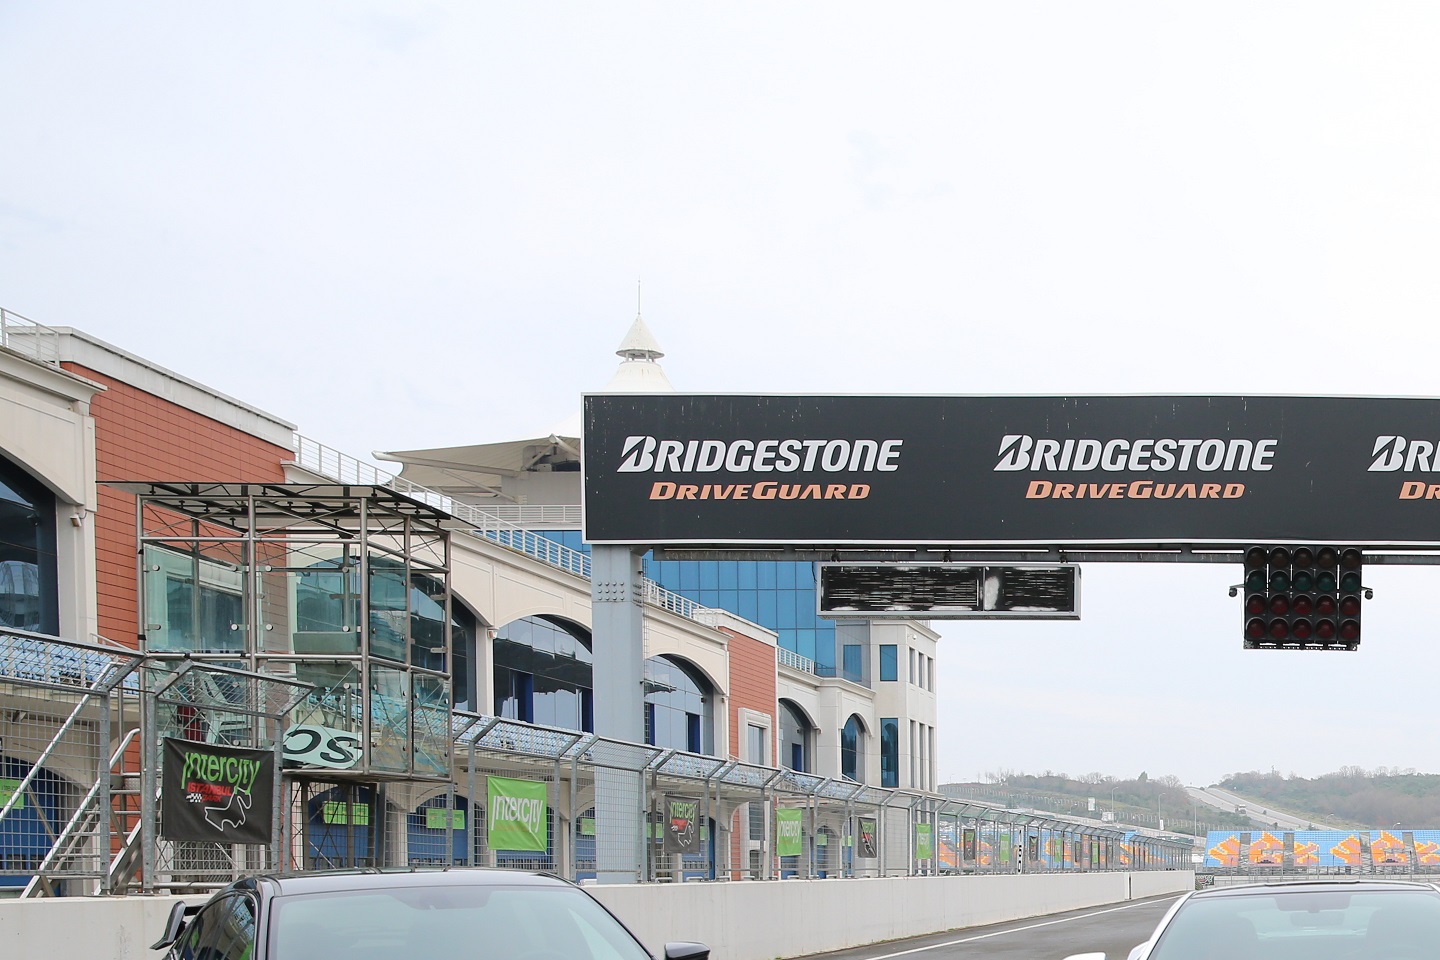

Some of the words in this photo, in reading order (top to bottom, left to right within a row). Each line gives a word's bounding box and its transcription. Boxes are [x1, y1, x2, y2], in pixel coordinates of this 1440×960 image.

[617, 436, 903, 472] BRIDGESTONE
[995, 435, 1277, 472] BRIDGESTONE
[491, 796, 543, 833] intercity
